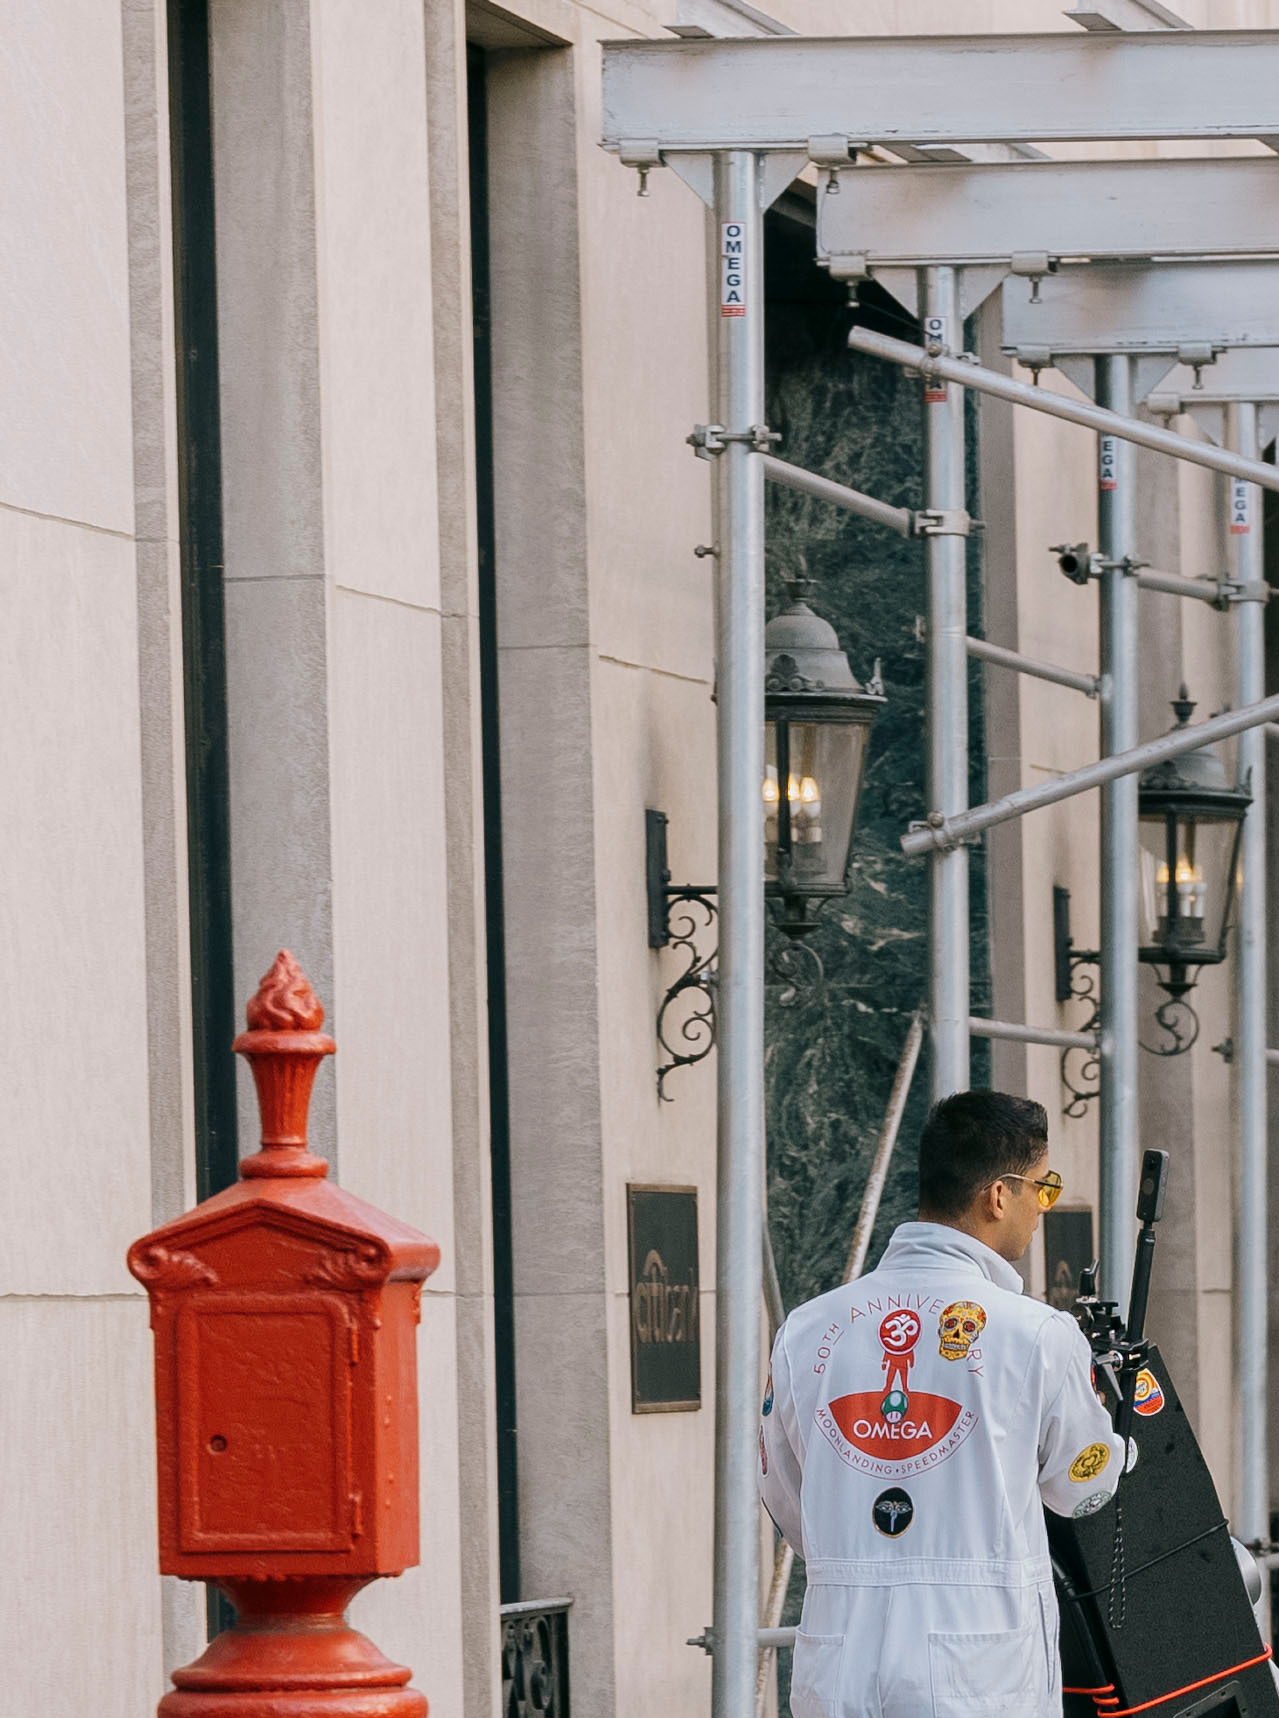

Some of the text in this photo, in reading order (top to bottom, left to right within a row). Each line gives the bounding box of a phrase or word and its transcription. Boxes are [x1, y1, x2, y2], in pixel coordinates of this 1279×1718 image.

[725, 225, 742, 303] OMEGA
[1102, 440, 1114, 478] EGA
[814, 1323, 840, 1375] 50TH
[851, 1294, 984, 1377] ANNIVERY
[816, 1408, 975, 1475] MOONLANDING SPEEDMASTER
[853, 1419, 933, 1440] OMEGA
